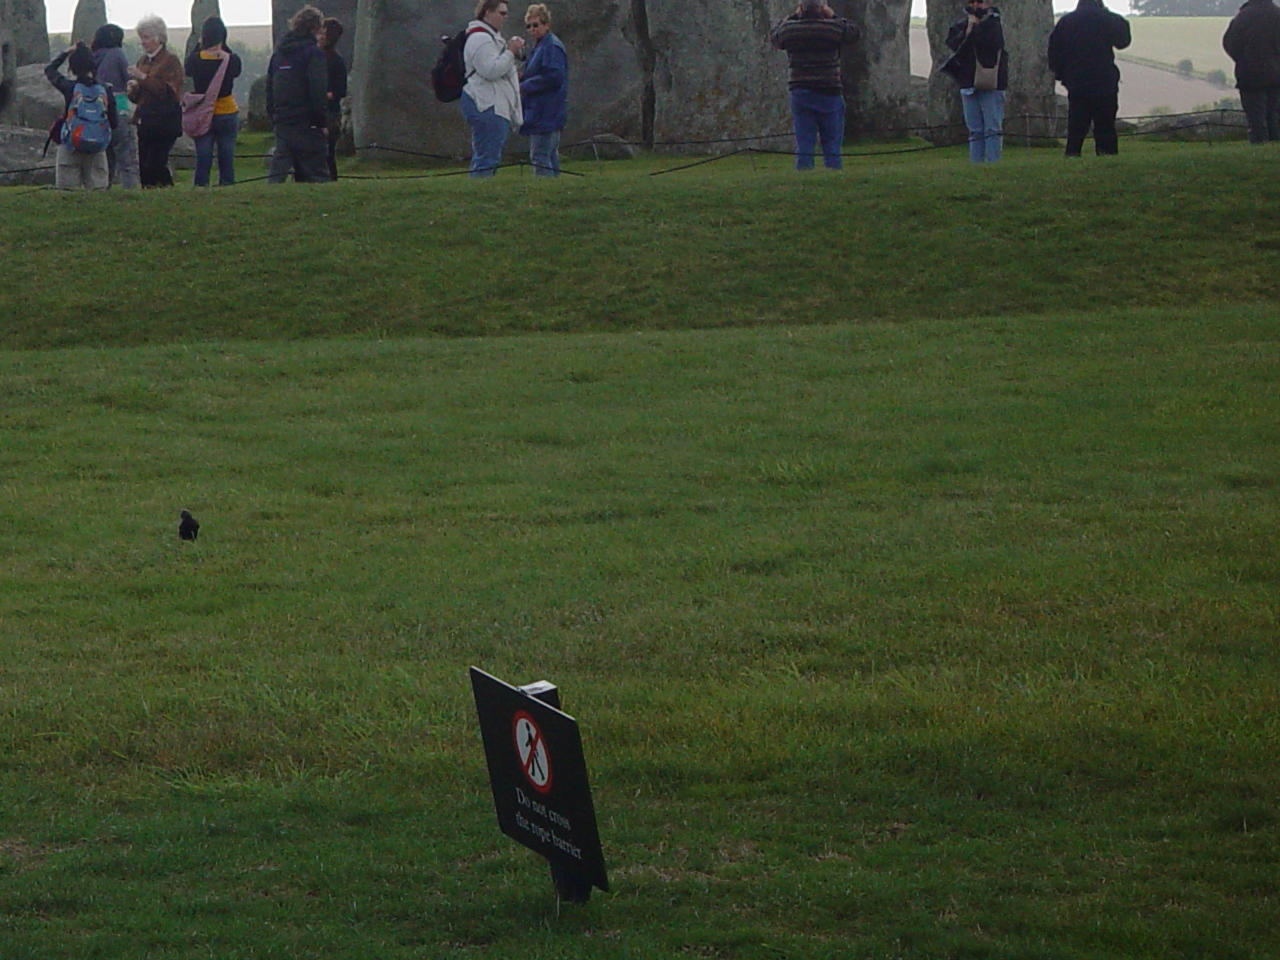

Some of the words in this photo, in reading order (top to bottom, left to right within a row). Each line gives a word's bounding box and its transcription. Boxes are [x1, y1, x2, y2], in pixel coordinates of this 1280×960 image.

[516, 787, 530, 808] Do
[532, 800, 548, 818] not
[548, 810, 571, 831] cross
[516, 811, 530, 830] the
[531, 823, 551, 842] rope
[551, 829, 582, 859] barrier
